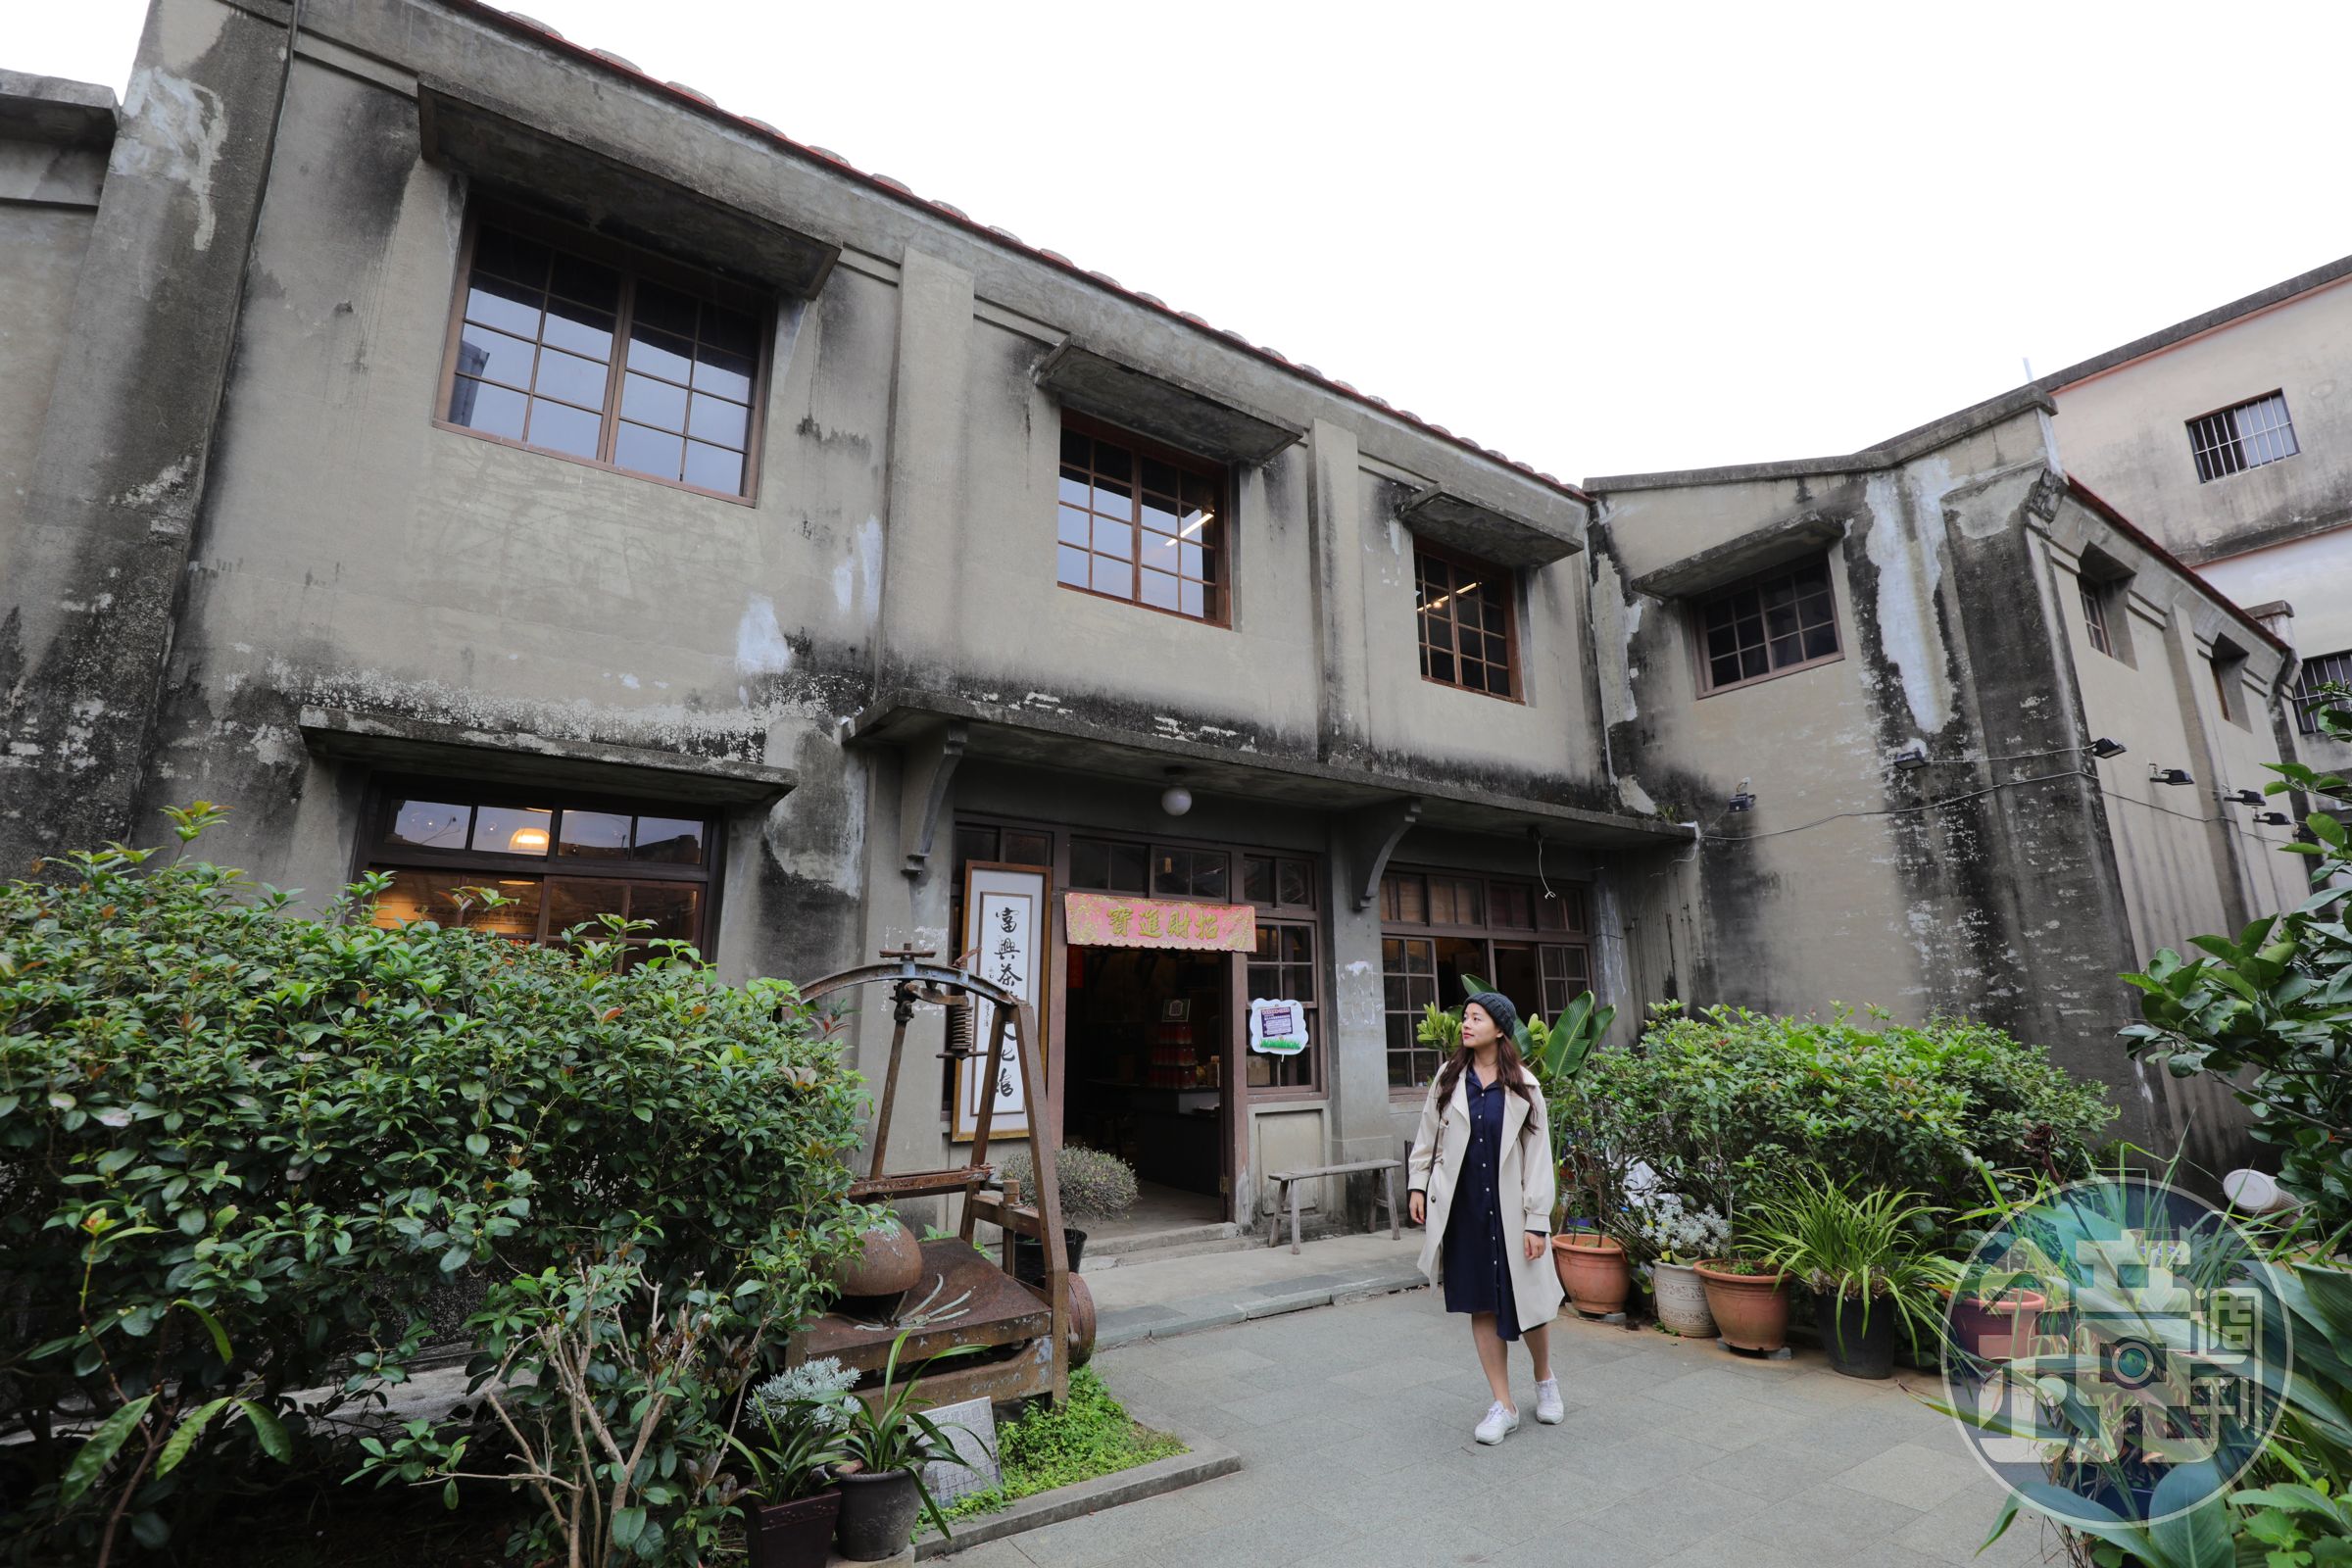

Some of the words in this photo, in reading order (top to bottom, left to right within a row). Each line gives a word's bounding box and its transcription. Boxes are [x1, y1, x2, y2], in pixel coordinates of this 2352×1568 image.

[994, 906, 1024, 1098] 富興茶化館
